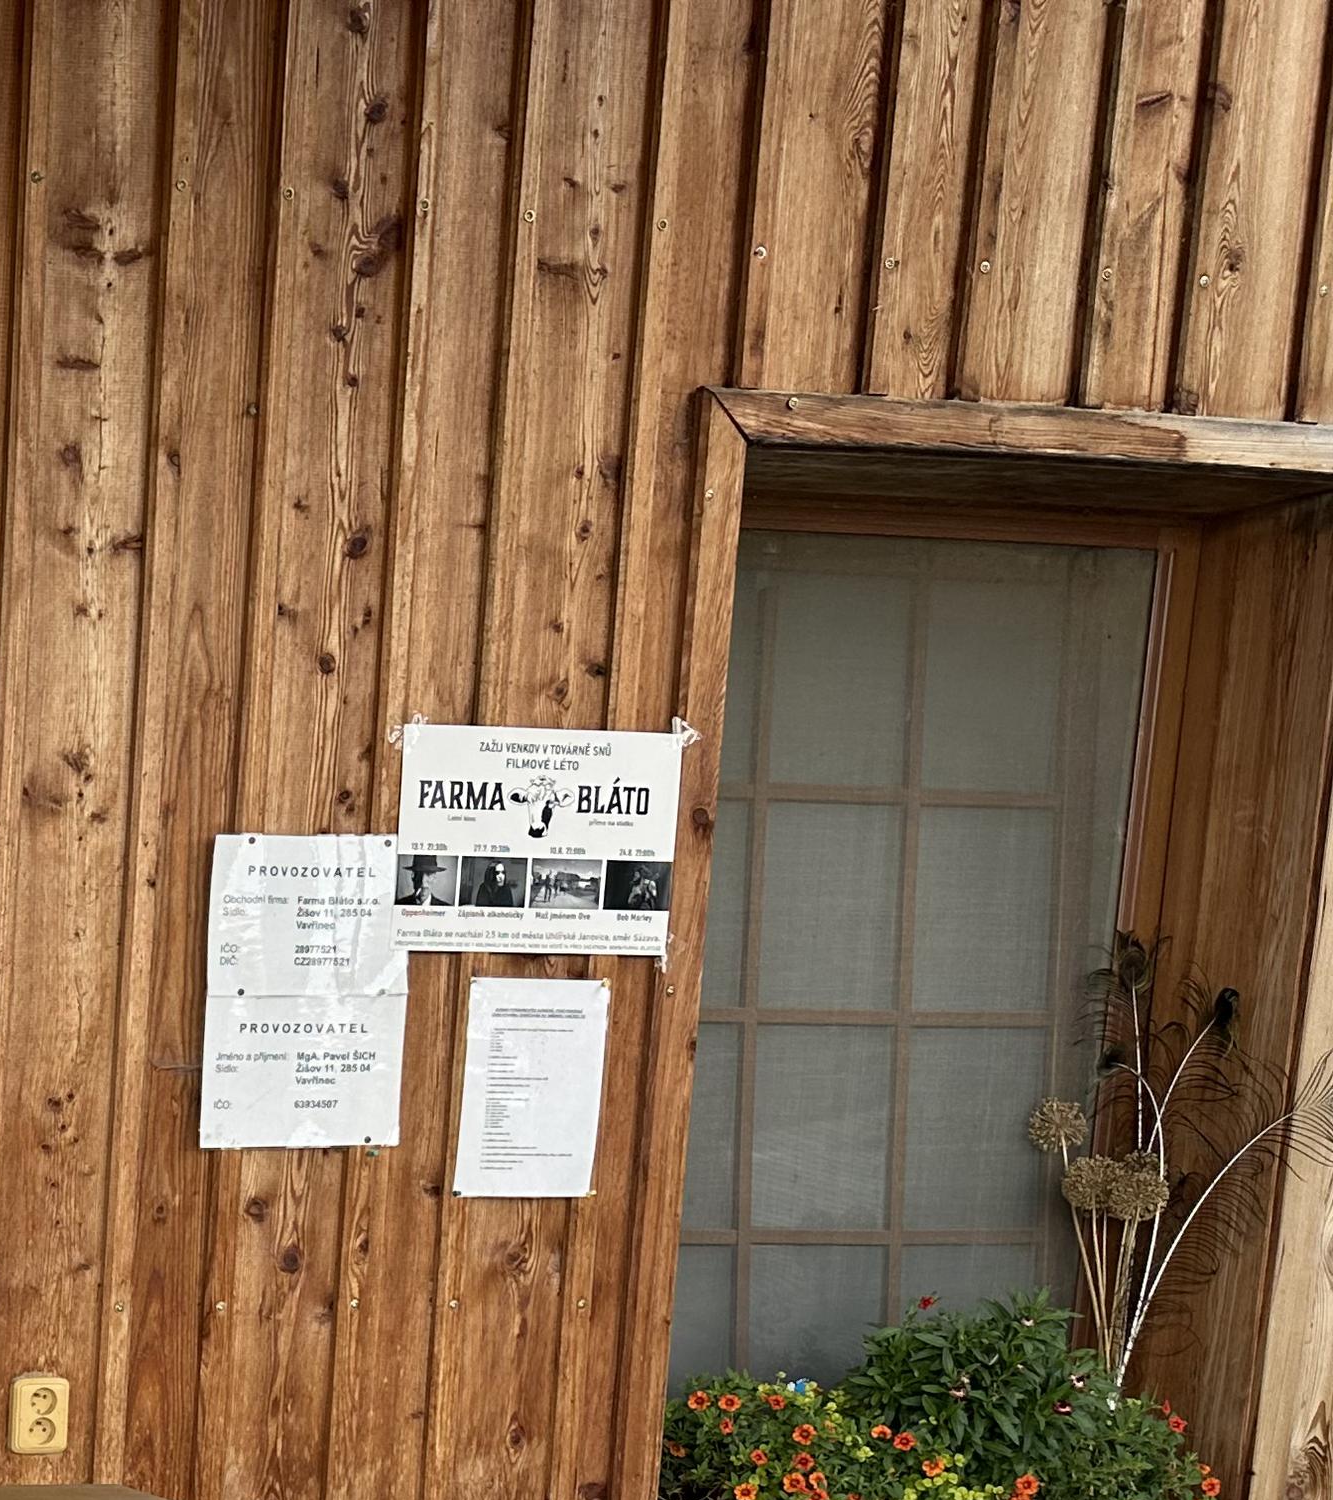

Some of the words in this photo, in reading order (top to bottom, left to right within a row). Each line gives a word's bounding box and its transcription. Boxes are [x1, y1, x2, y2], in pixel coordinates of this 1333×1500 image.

[505, 742, 541, 754] VENKOV
[542, 744, 548, 754] V
[550, 742, 591, 756] TOVÁRNĚ
[593, 742, 612, 756] SNŮ
[506, 757, 551, 770] FILMOVÉ
[553, 758, 579, 771] LÉTO
[418, 779, 507, 811] FARMA
[576, 776, 650, 816] BLÁTO
[247, 865, 377, 878] PROVOZOVATEL
[223, 894, 267, 905] Obchodní
[297, 896, 326, 906] Farma
[328, 896, 355, 906] Bláto
[340, 908, 359, 918] 285
[360, 908, 372, 918] 04
[239, 1023, 370, 1034] PROVOZOVATEL
[215, 1051, 244, 1061] Jméno
[323, 1051, 350, 1061] Pavel
[352, 1049, 376, 1061] ŠICH
[340, 1063, 358, 1073] 285
[359, 1063, 371, 1073] 04
